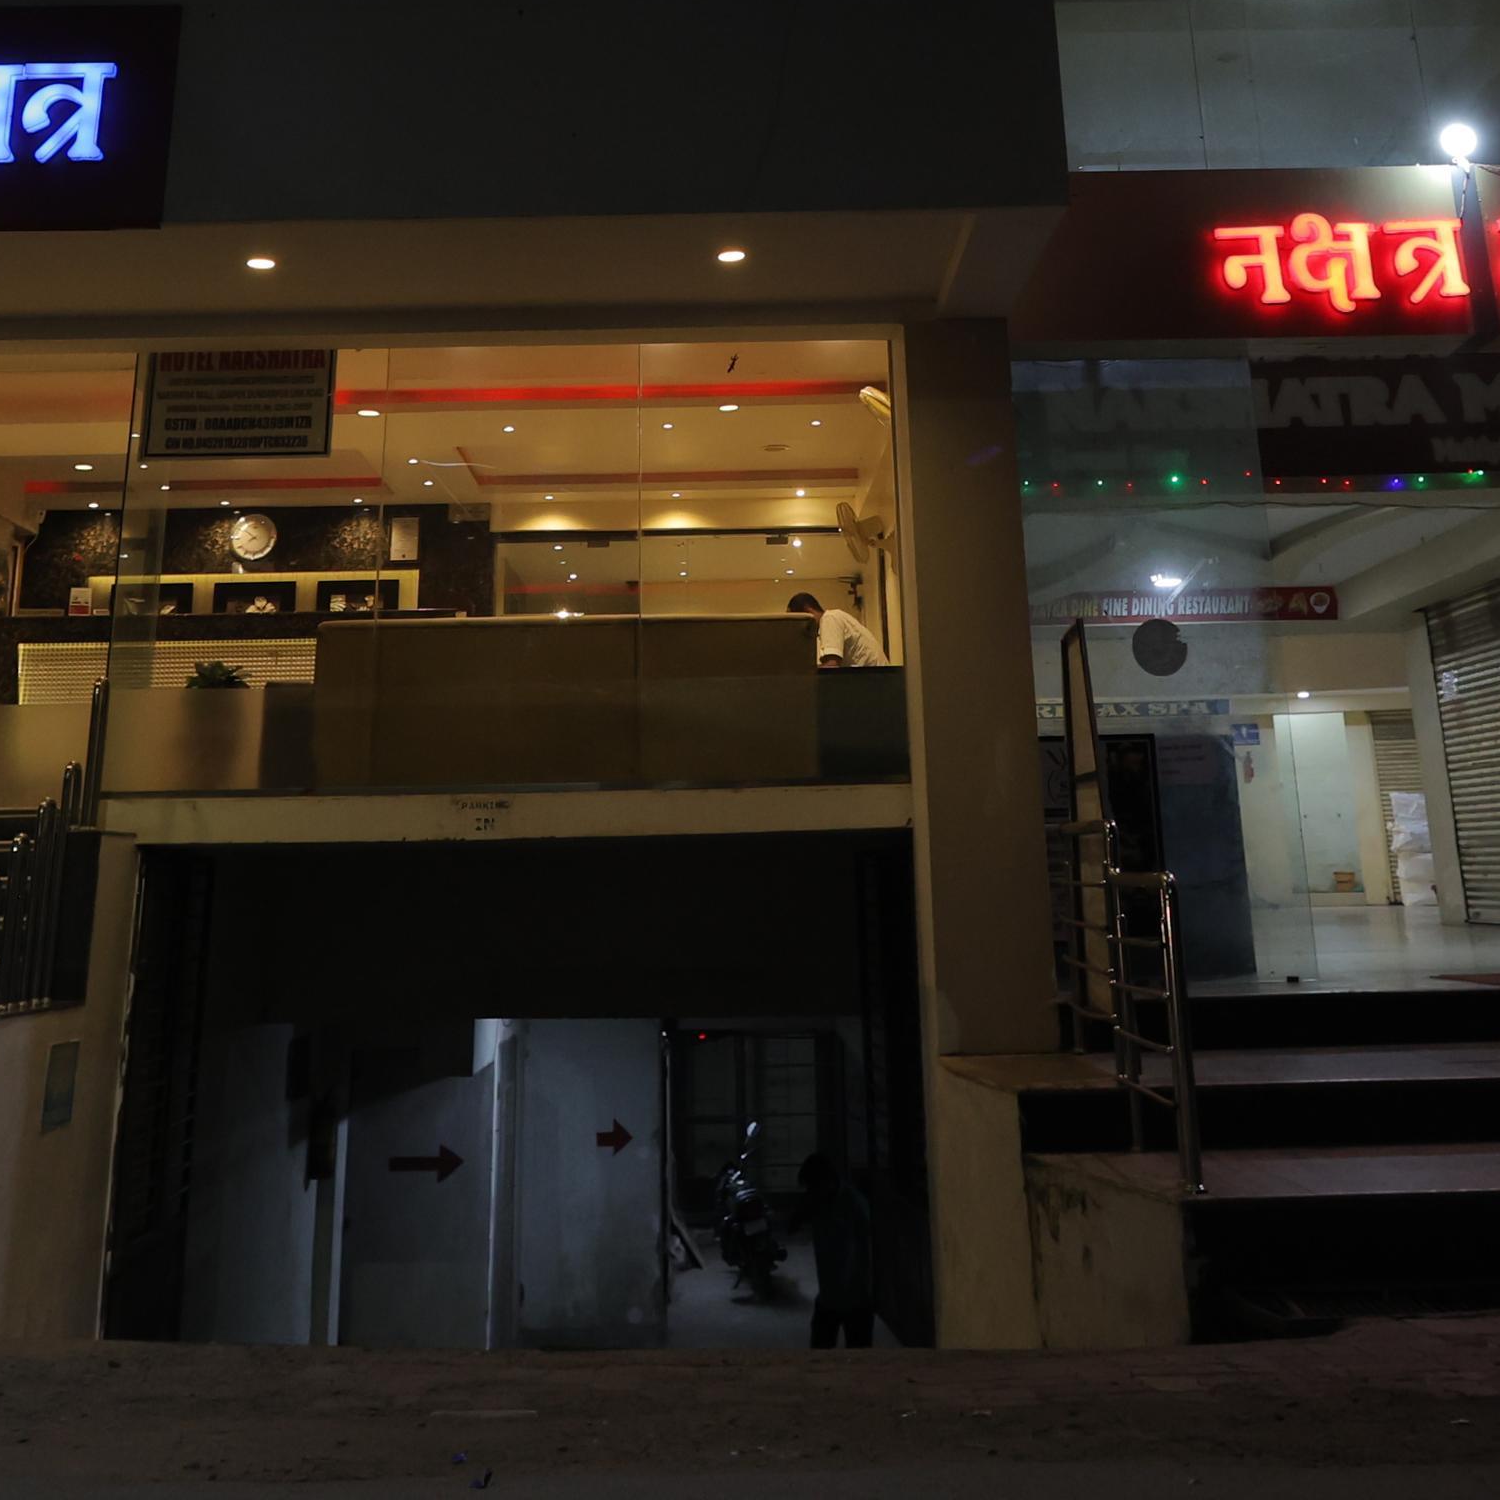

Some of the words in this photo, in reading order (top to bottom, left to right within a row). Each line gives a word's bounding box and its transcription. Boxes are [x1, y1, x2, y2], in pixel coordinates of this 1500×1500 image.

[1213, 212, 1471, 313] नक्षत्र
[160, 350, 214, 372] HOTEL
[219, 349, 325, 372] NAKSHATRA
[1102, 597, 1128, 616] FINE
[1132, 597, 1174, 616] DINING
[1178, 595, 1249, 615] RESTAURANT
